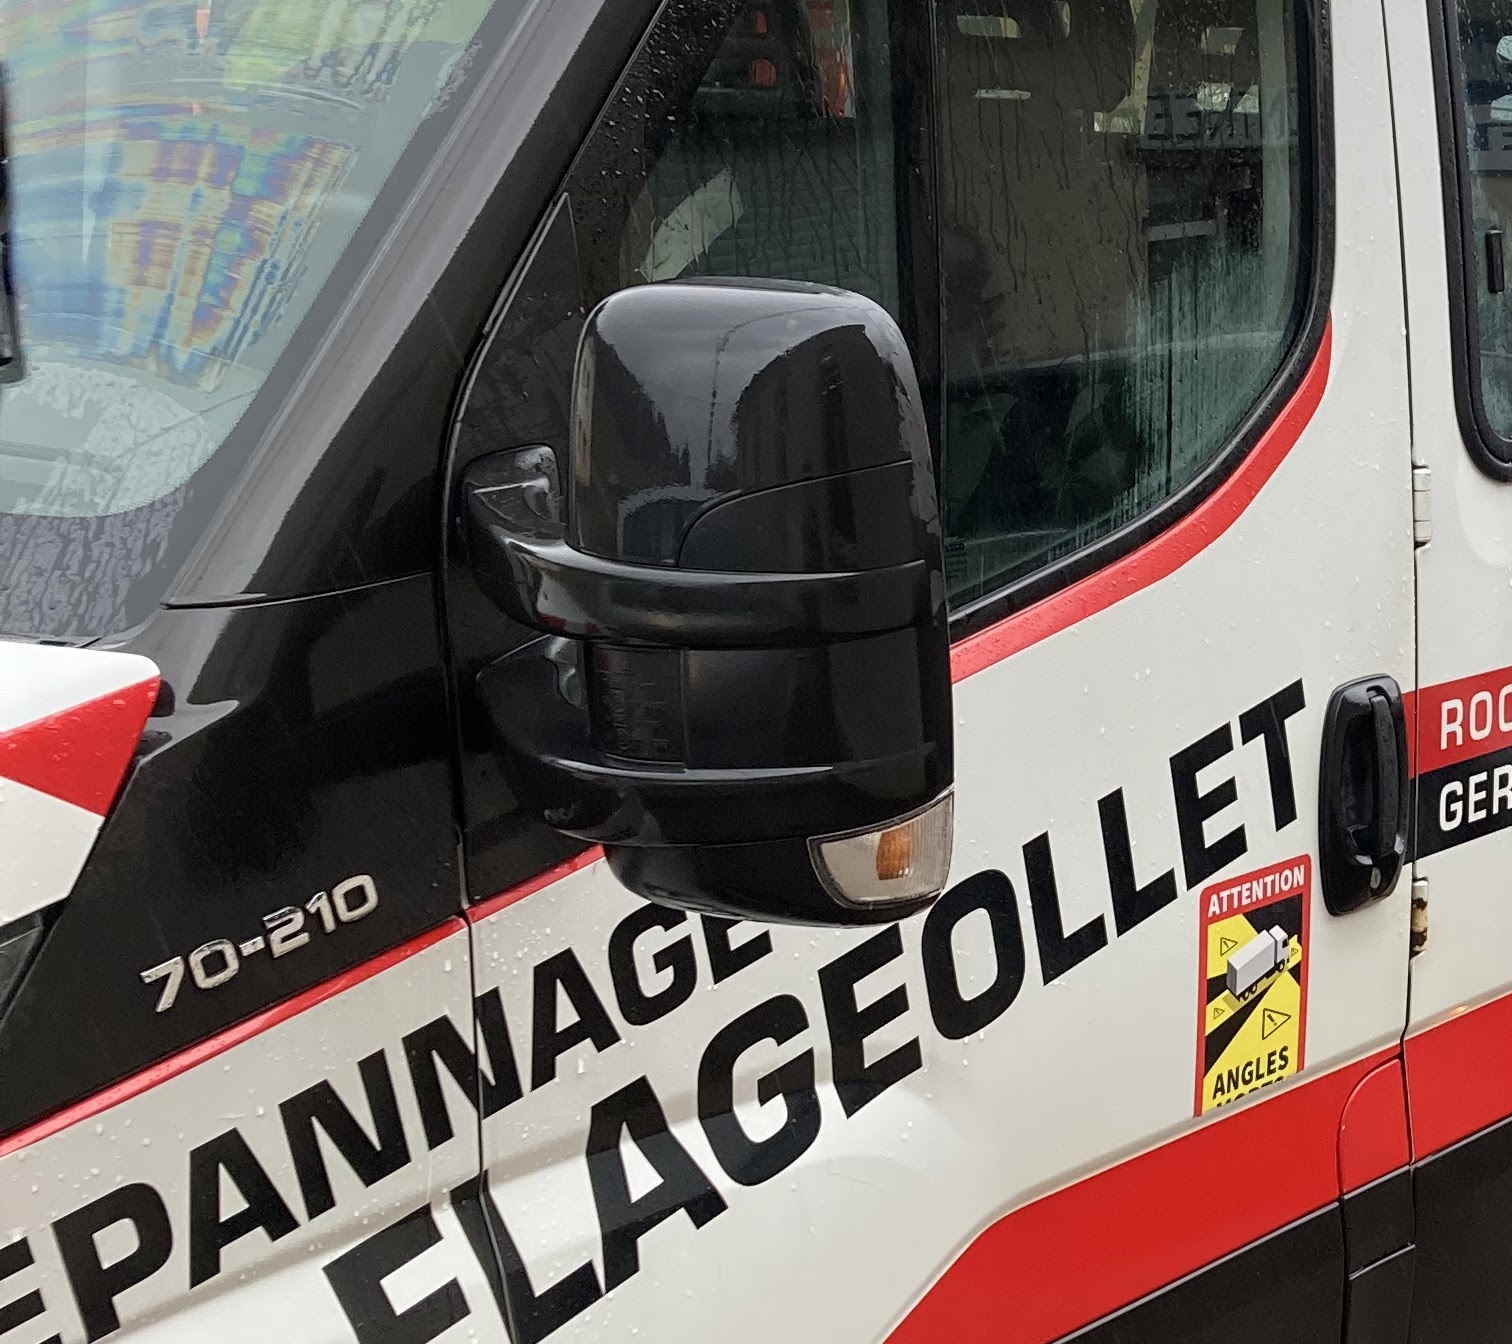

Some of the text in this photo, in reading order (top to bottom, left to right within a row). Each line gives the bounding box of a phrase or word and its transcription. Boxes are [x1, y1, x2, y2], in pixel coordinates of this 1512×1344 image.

[1207, 864, 1305, 918] ATTENTION
[139, 874, 379, 1013] 70-210
[1212, 1045, 1289, 1100] ANGLES
